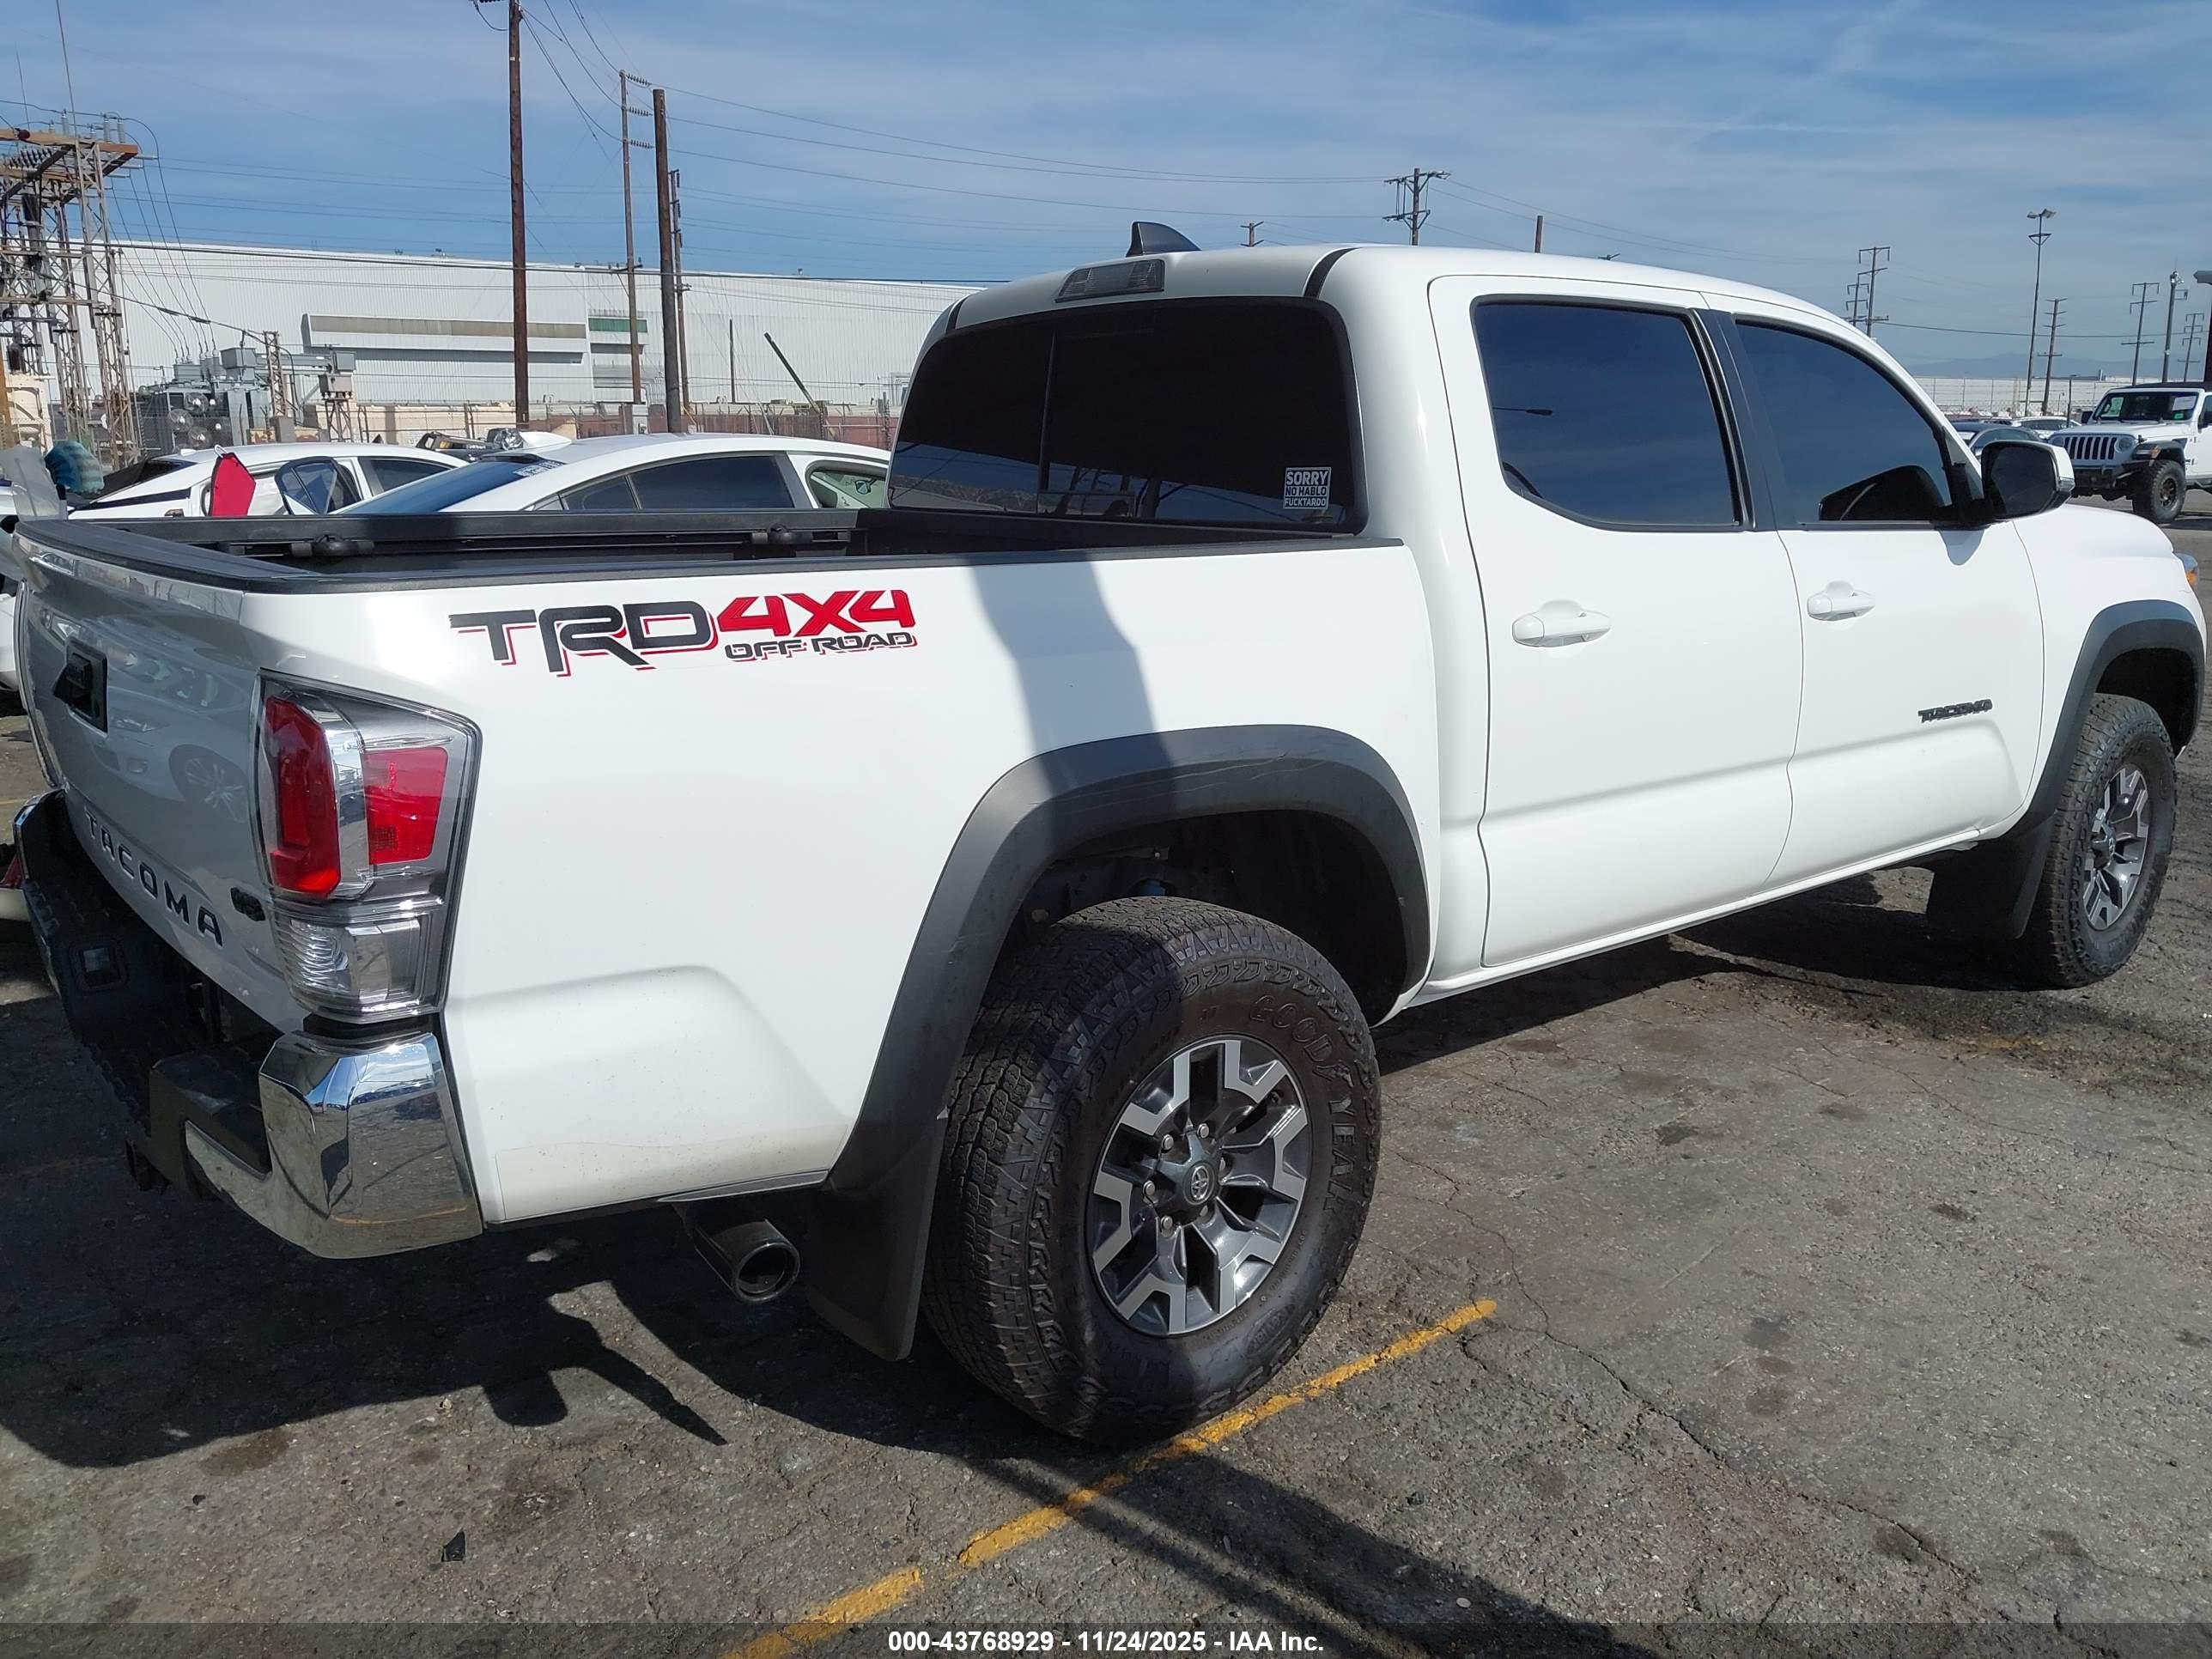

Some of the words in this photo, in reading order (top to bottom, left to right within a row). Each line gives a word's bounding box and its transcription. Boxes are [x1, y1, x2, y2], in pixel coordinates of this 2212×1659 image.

[1286, 471, 1328, 485] SORRY
[1285, 486, 1297, 496] NO
[1298, 486, 1327, 496] HABLO
[1285, 497, 1327, 507] FUCKTARDO
[449, 600, 719, 677] TRD
[725, 638, 805, 663] OFF
[812, 630, 918, 654] ROAD
[84, 808, 223, 948] TACOMA
